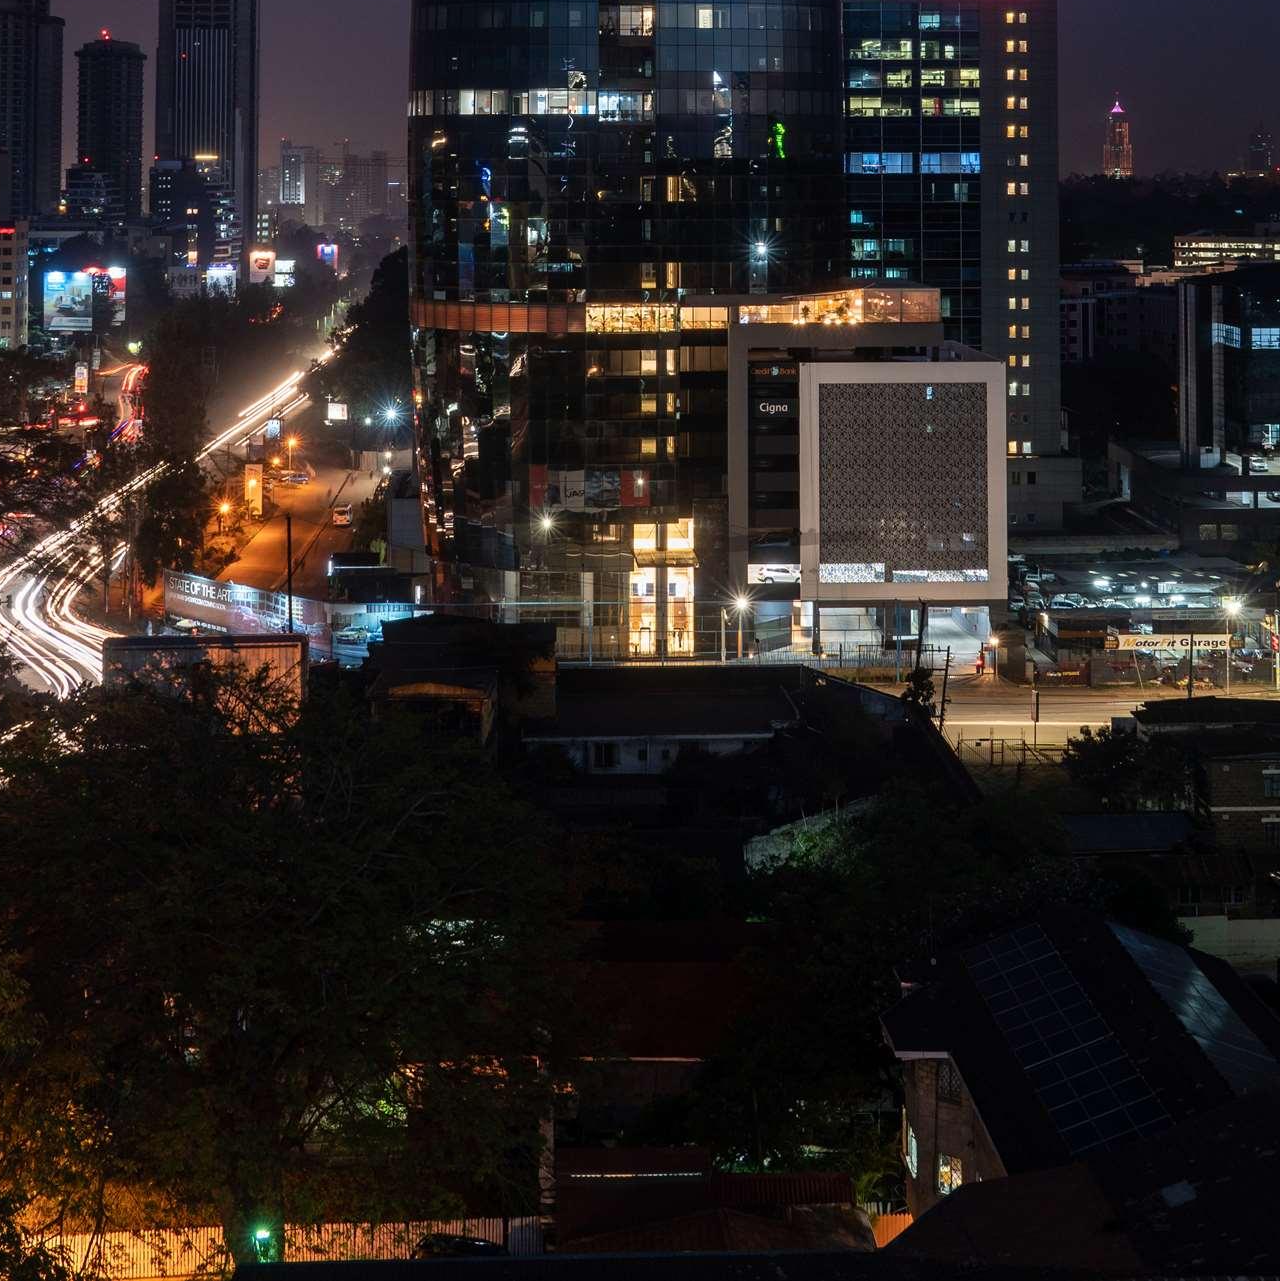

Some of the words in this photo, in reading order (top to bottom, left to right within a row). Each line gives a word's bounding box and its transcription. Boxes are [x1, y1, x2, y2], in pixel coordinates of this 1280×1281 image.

[760, 402, 788, 414] Cigna
[169, 576, 190, 593] STATE
[190, 581, 201, 595] OF
[201, 583, 216, 599] THE
[1180, 638, 1227, 649] Garage
